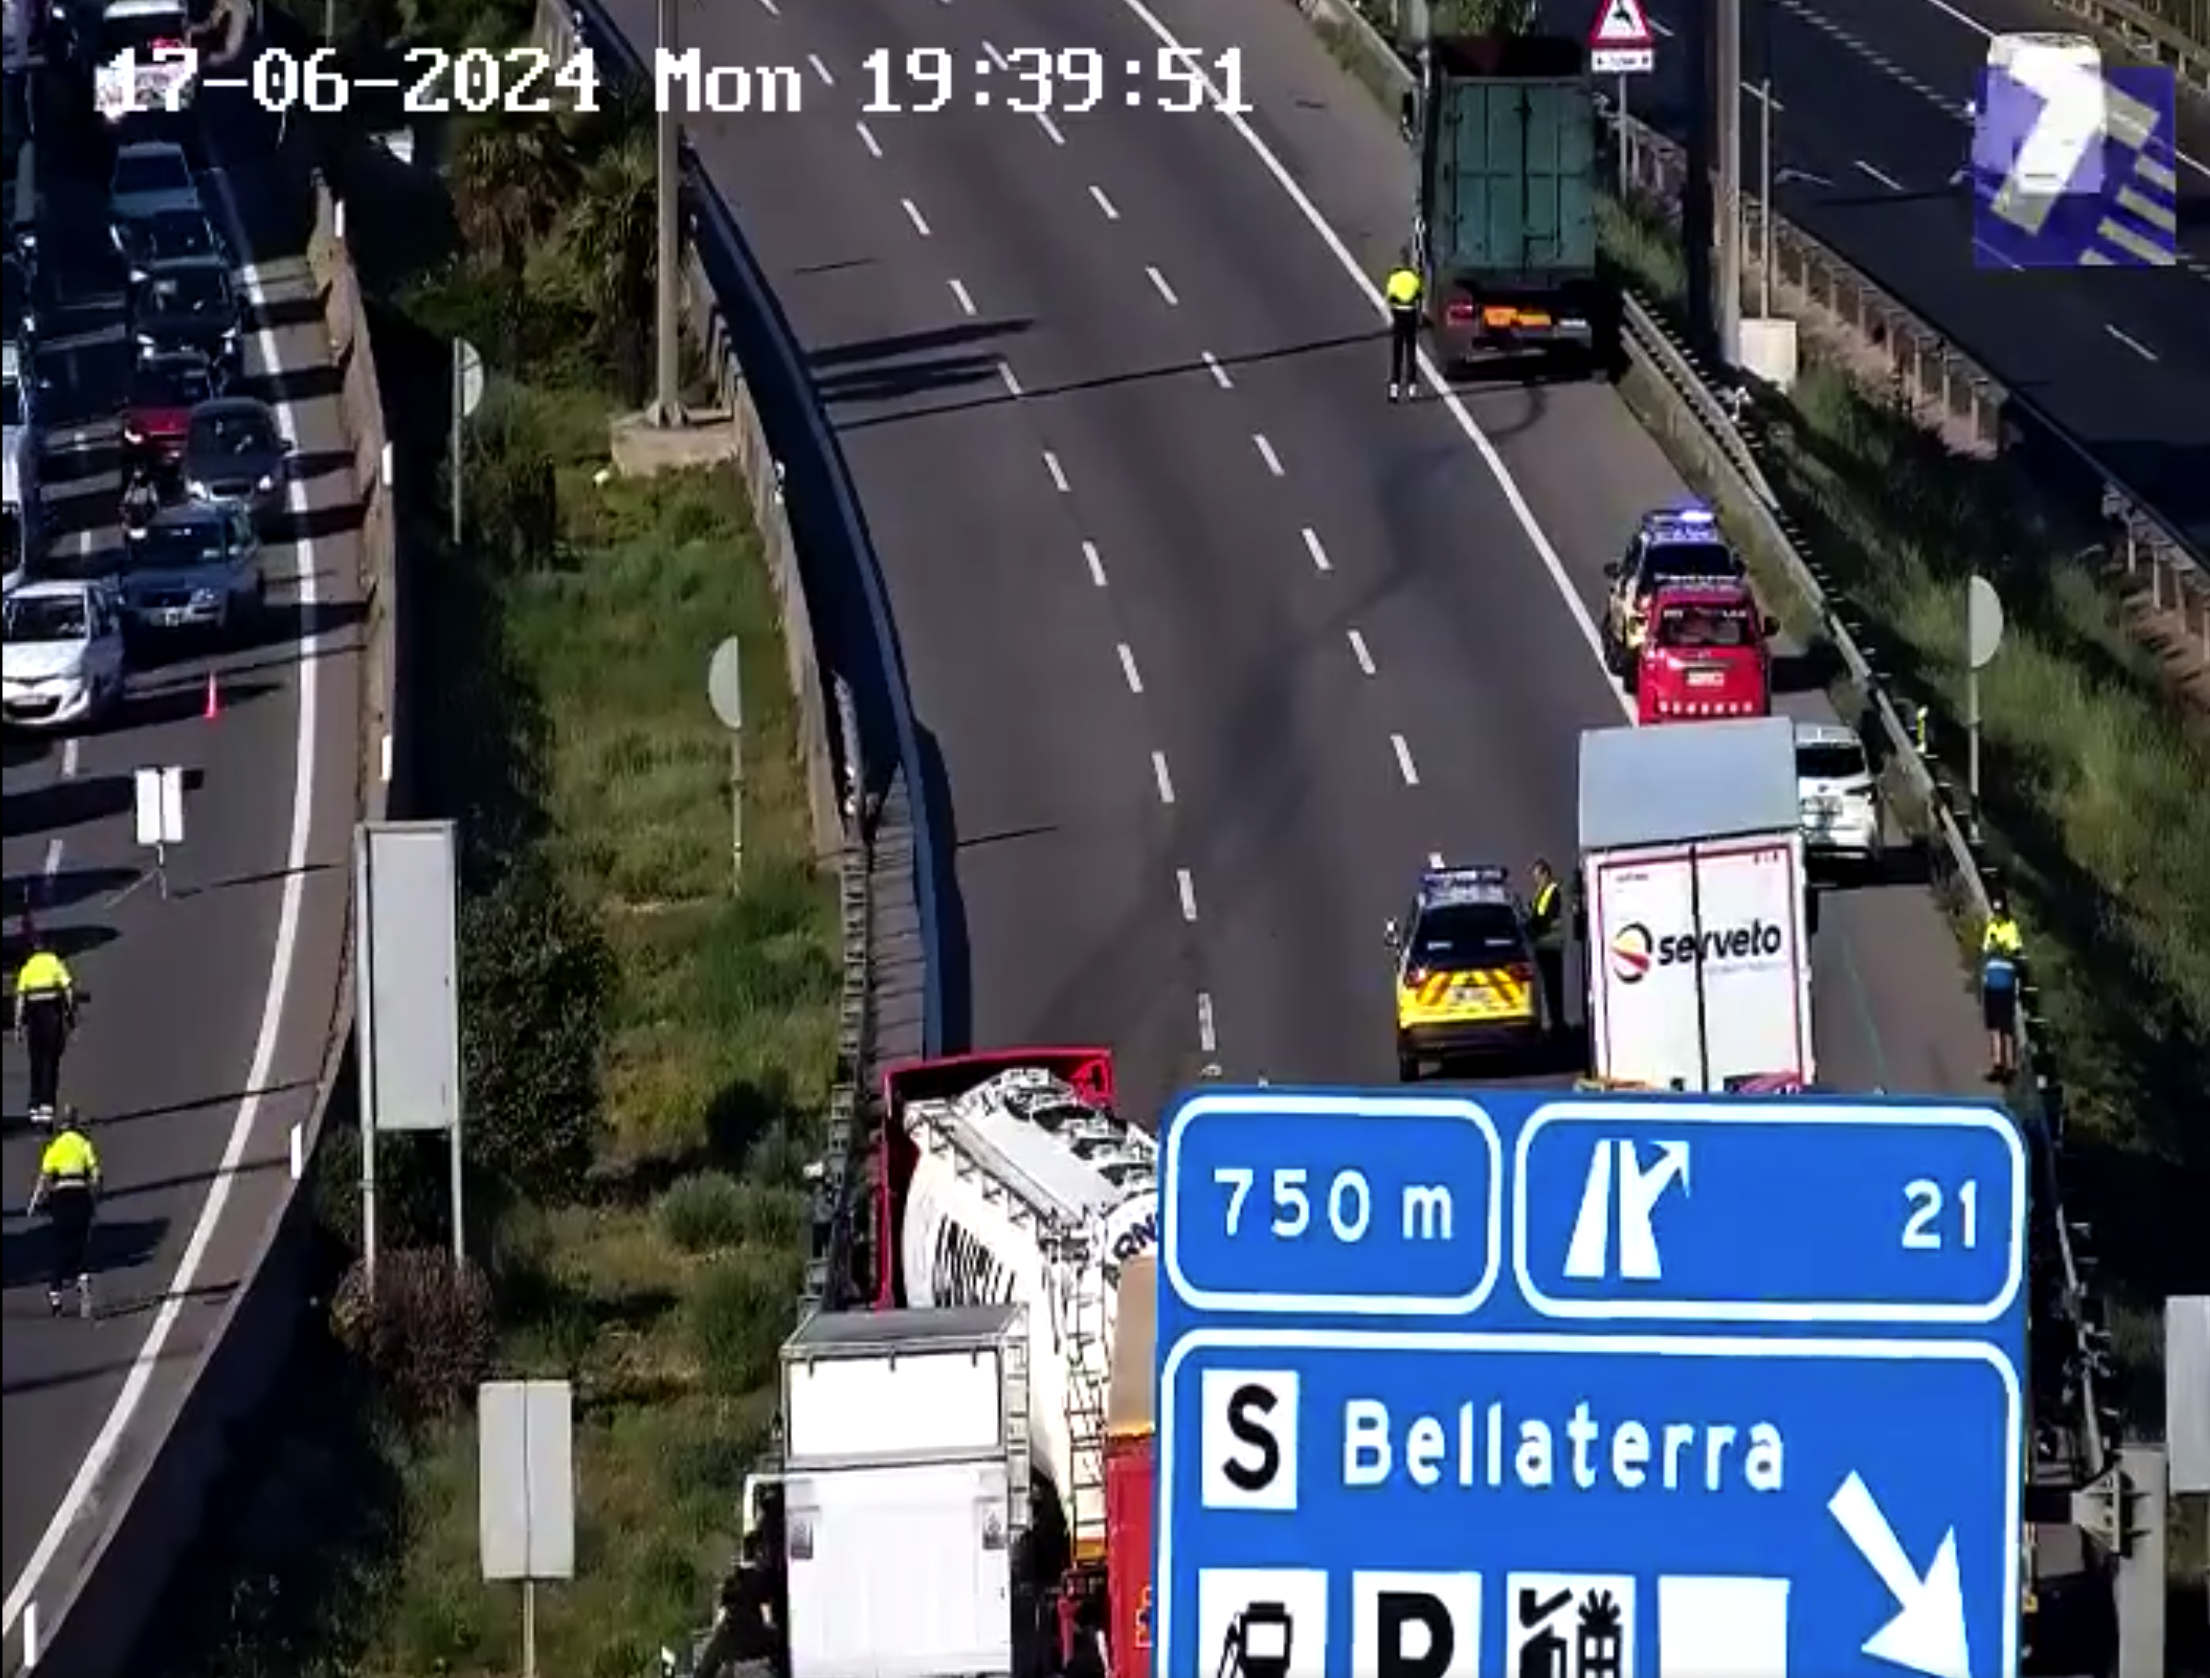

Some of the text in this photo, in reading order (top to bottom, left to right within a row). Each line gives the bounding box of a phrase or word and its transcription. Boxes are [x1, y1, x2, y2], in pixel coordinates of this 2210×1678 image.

[1658, 917, 1782, 966] serveto
[1214, 1168, 1453, 1243] 750 m
[1902, 1179, 1977, 1249] 21
[1222, 1383, 1785, 1492] S Bellaterra
